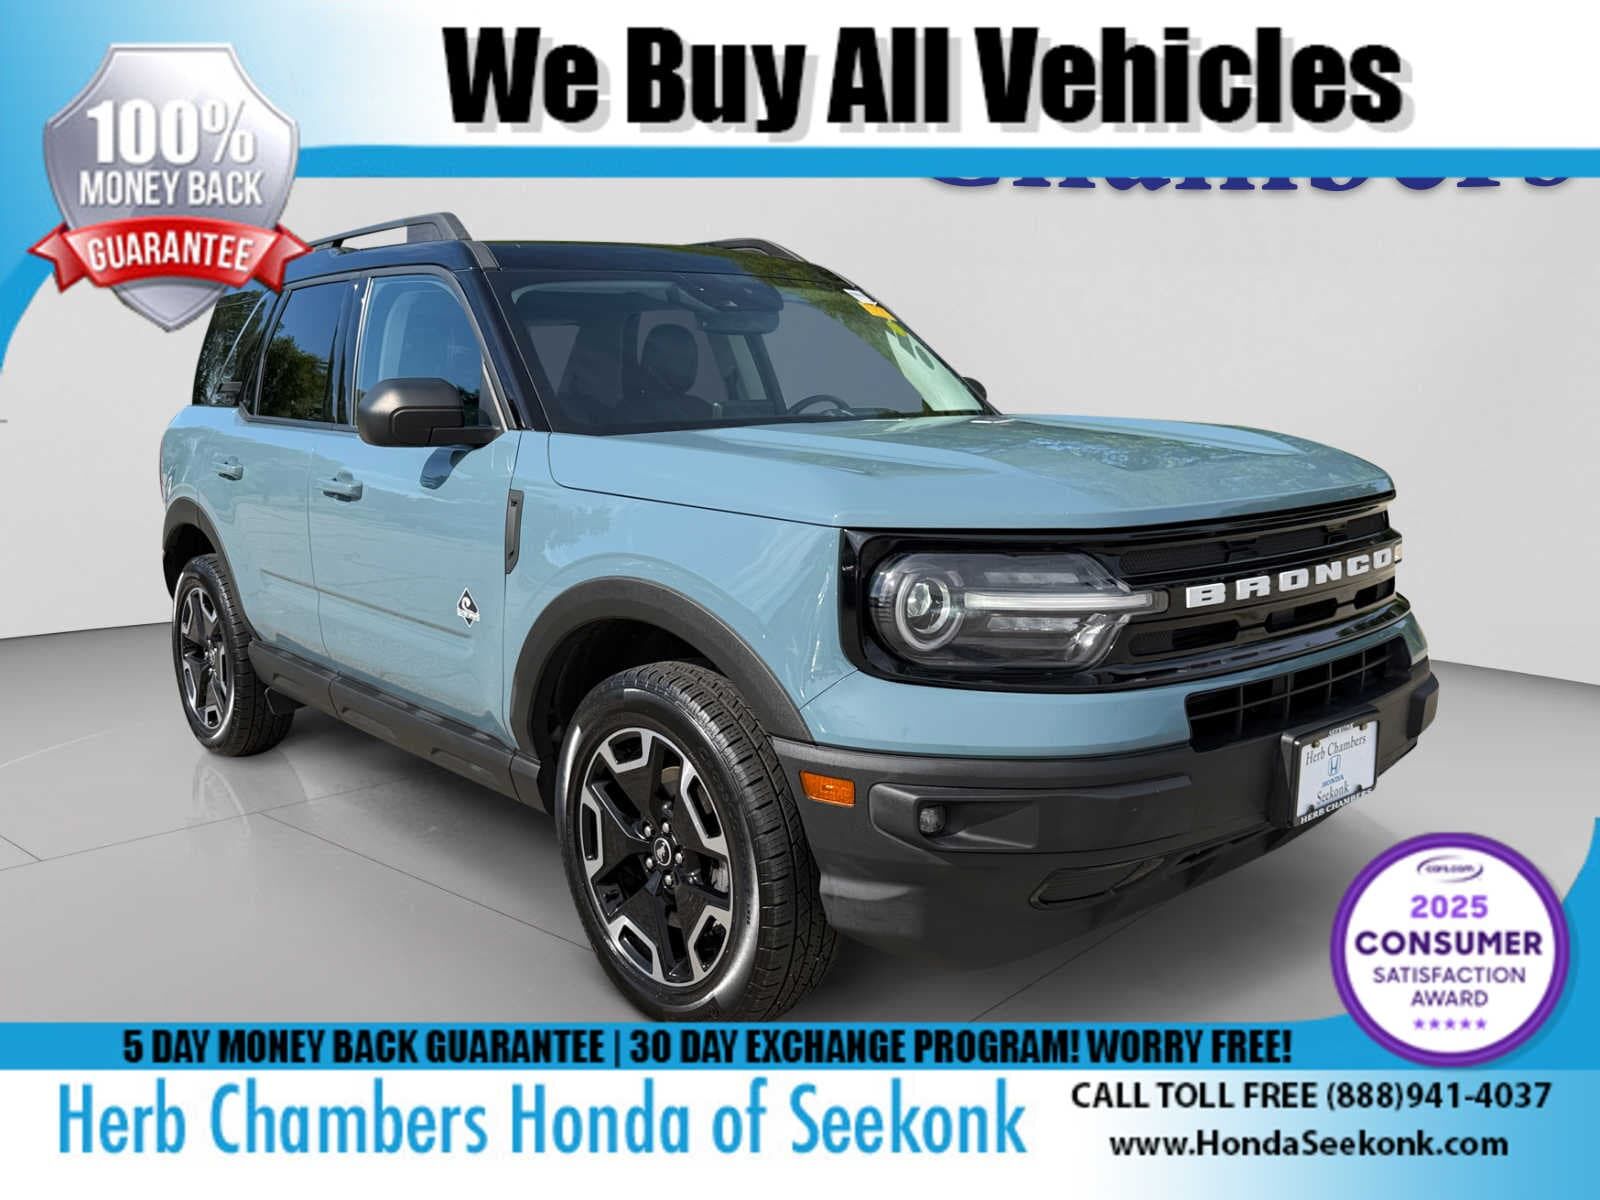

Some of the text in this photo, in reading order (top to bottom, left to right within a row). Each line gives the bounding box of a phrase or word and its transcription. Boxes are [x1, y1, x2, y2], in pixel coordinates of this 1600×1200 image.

[1186, 547, 1392, 609] BRONCO
[1305, 735, 1368, 765] Herb Chambers
[1316, 780, 1350, 802] Seekonk
